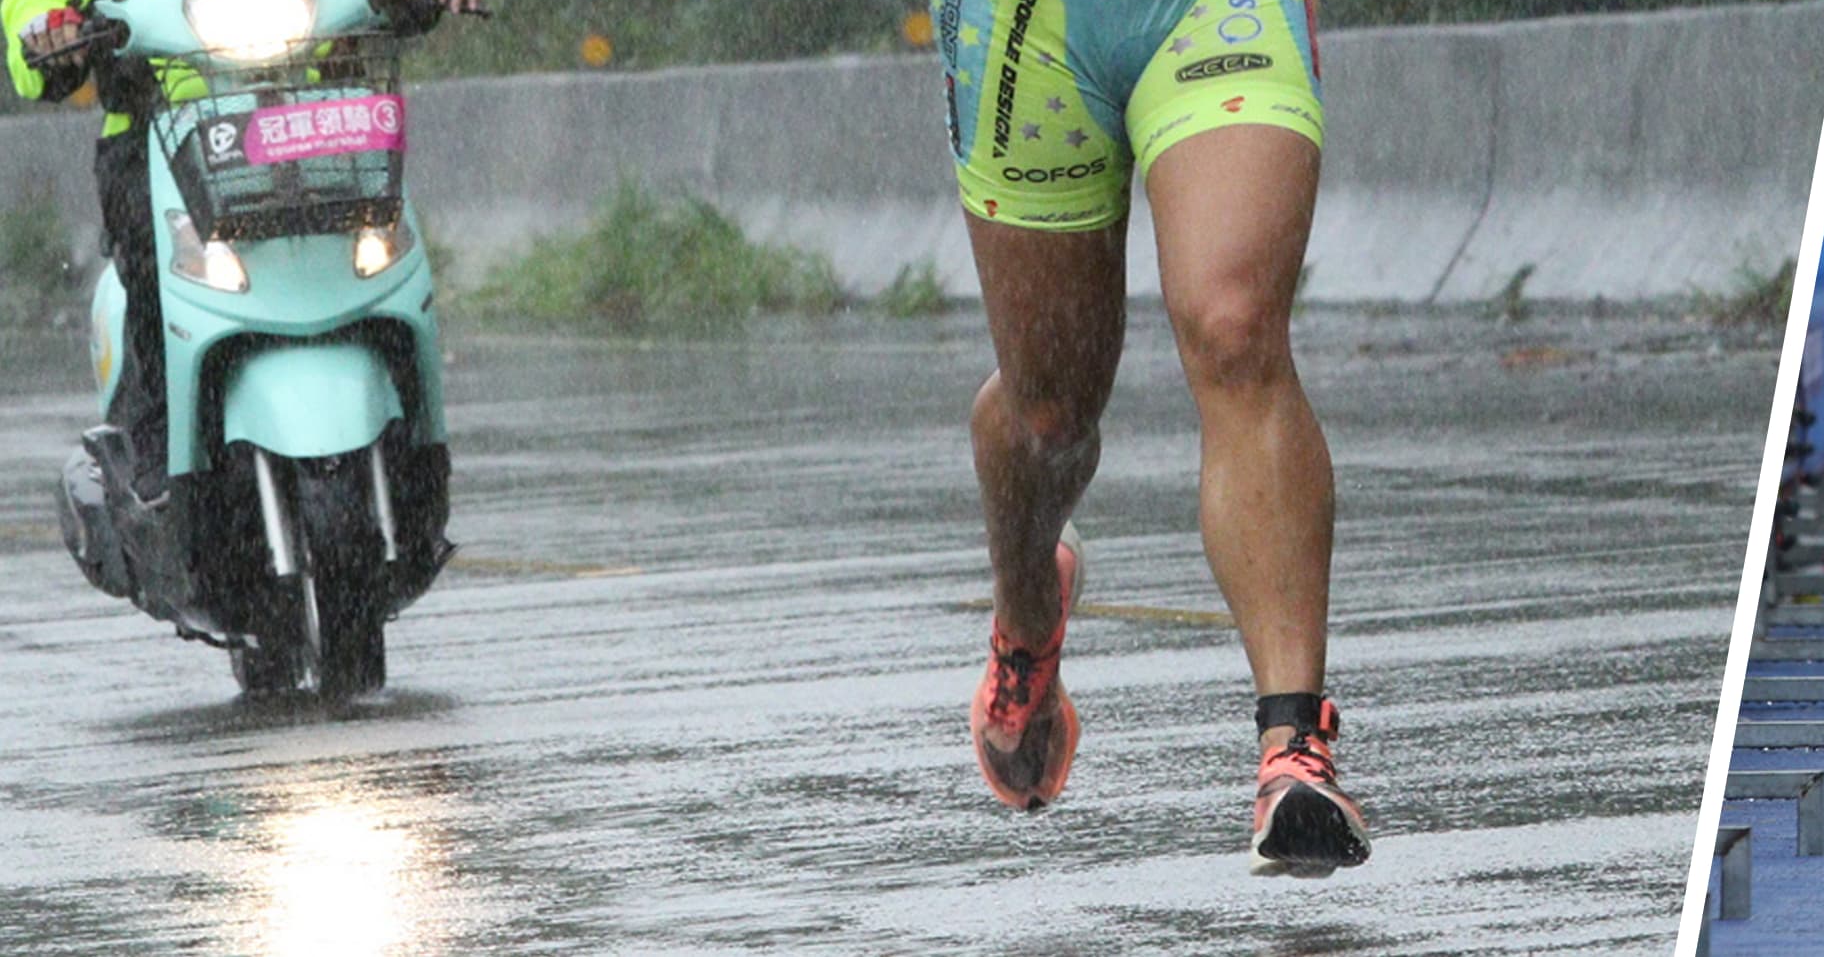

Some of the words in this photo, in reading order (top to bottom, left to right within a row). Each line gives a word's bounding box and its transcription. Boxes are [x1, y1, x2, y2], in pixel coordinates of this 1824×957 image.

[1179, 54, 1270, 81] KEEN
[994, 63, 1018, 151] DESIGN
[258, 105, 373, 145] 冠軍領騎
[1002, 157, 1107, 183] OOFOS
